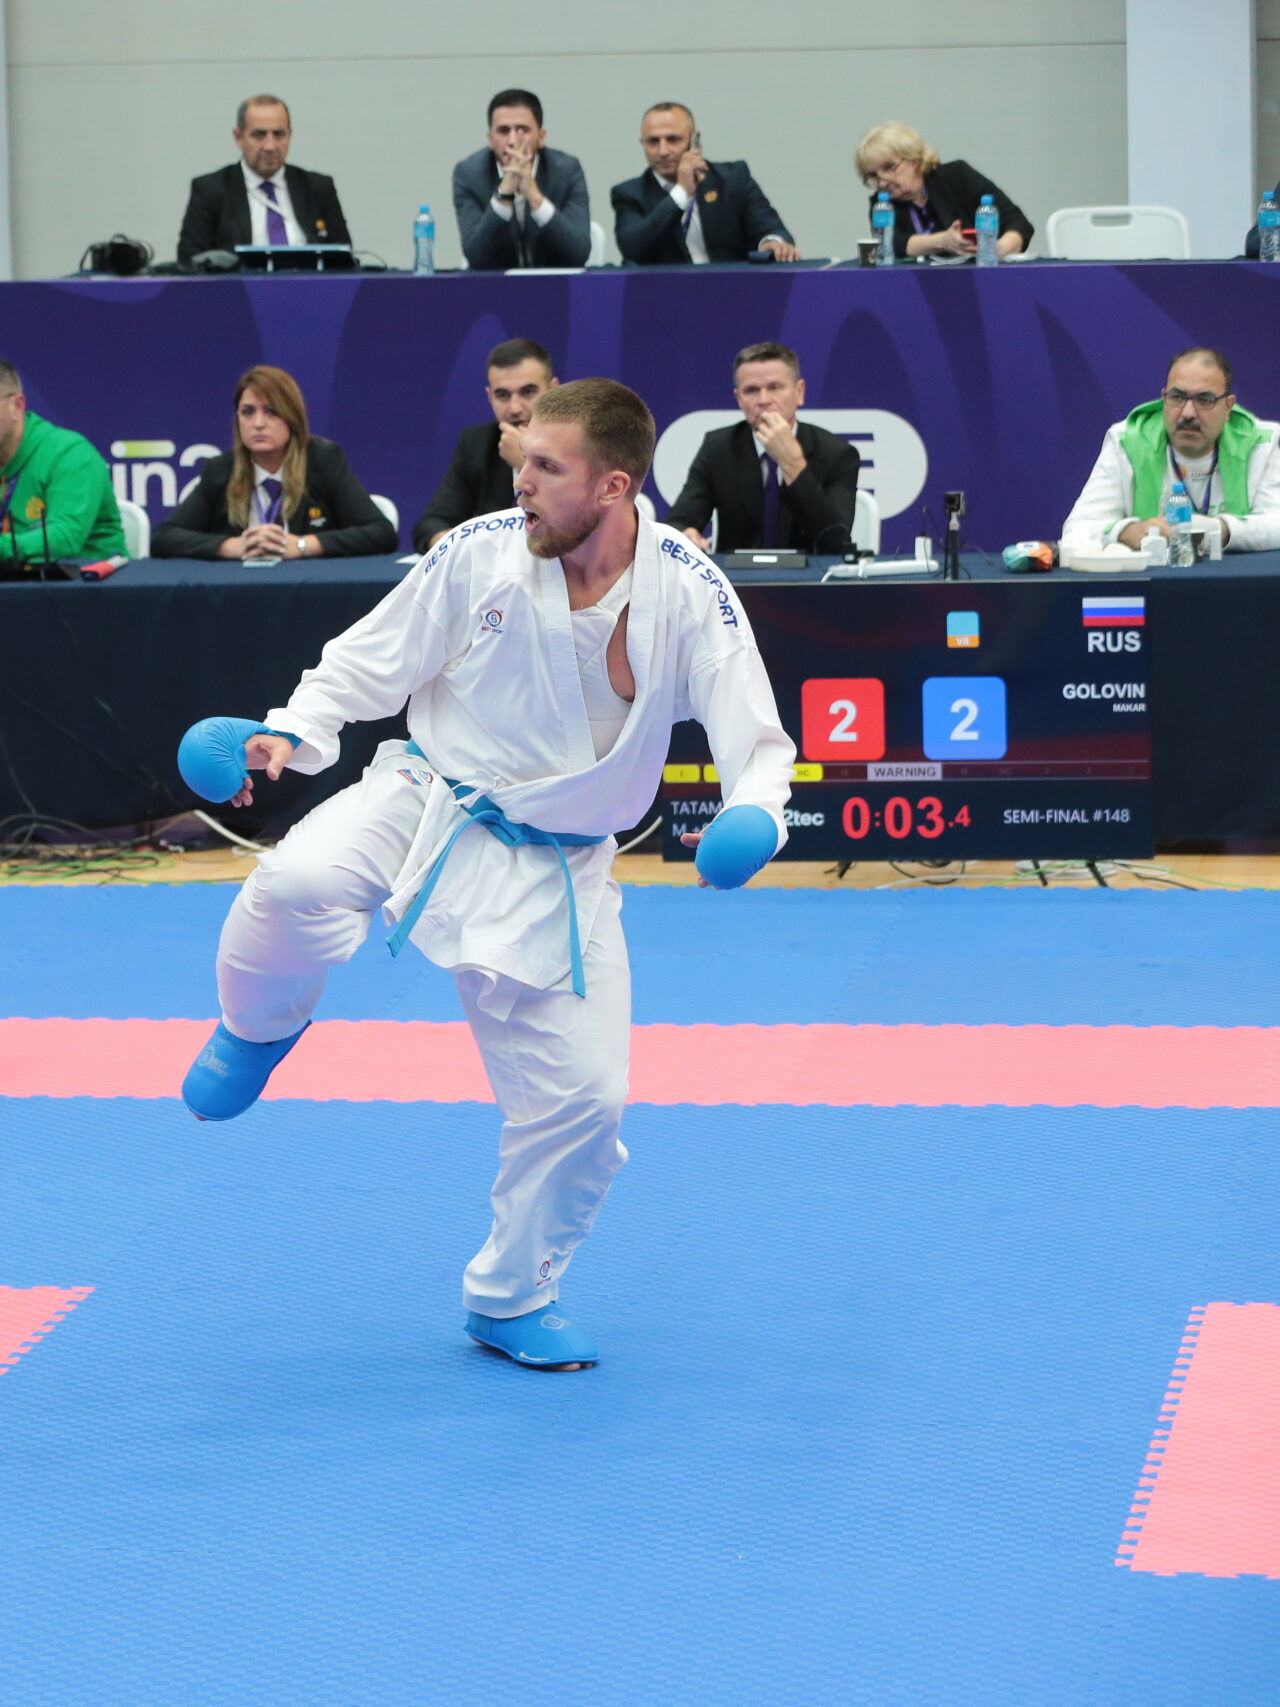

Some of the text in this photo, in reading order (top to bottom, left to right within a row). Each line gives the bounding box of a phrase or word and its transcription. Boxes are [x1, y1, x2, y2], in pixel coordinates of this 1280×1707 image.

[459, 516, 527, 539] SPORT
[661, 538, 738, 628] BEST SPORT
[955, 636, 971, 646] VR
[1087, 631, 1142, 653] RUS
[1062, 683, 1146, 700] GOLOVIN
[1112, 703, 1147, 713] MAKAR
[828, 699, 858, 742] 2
[949, 698, 980, 741] 2
[874, 766, 937, 778] WARNING
[671, 801, 723, 815] TATAM
[1003, 808, 1130, 824] SEMI-FINAL #148
[783, 808, 825, 827] 2tec
[672, 823, 687, 836] M
